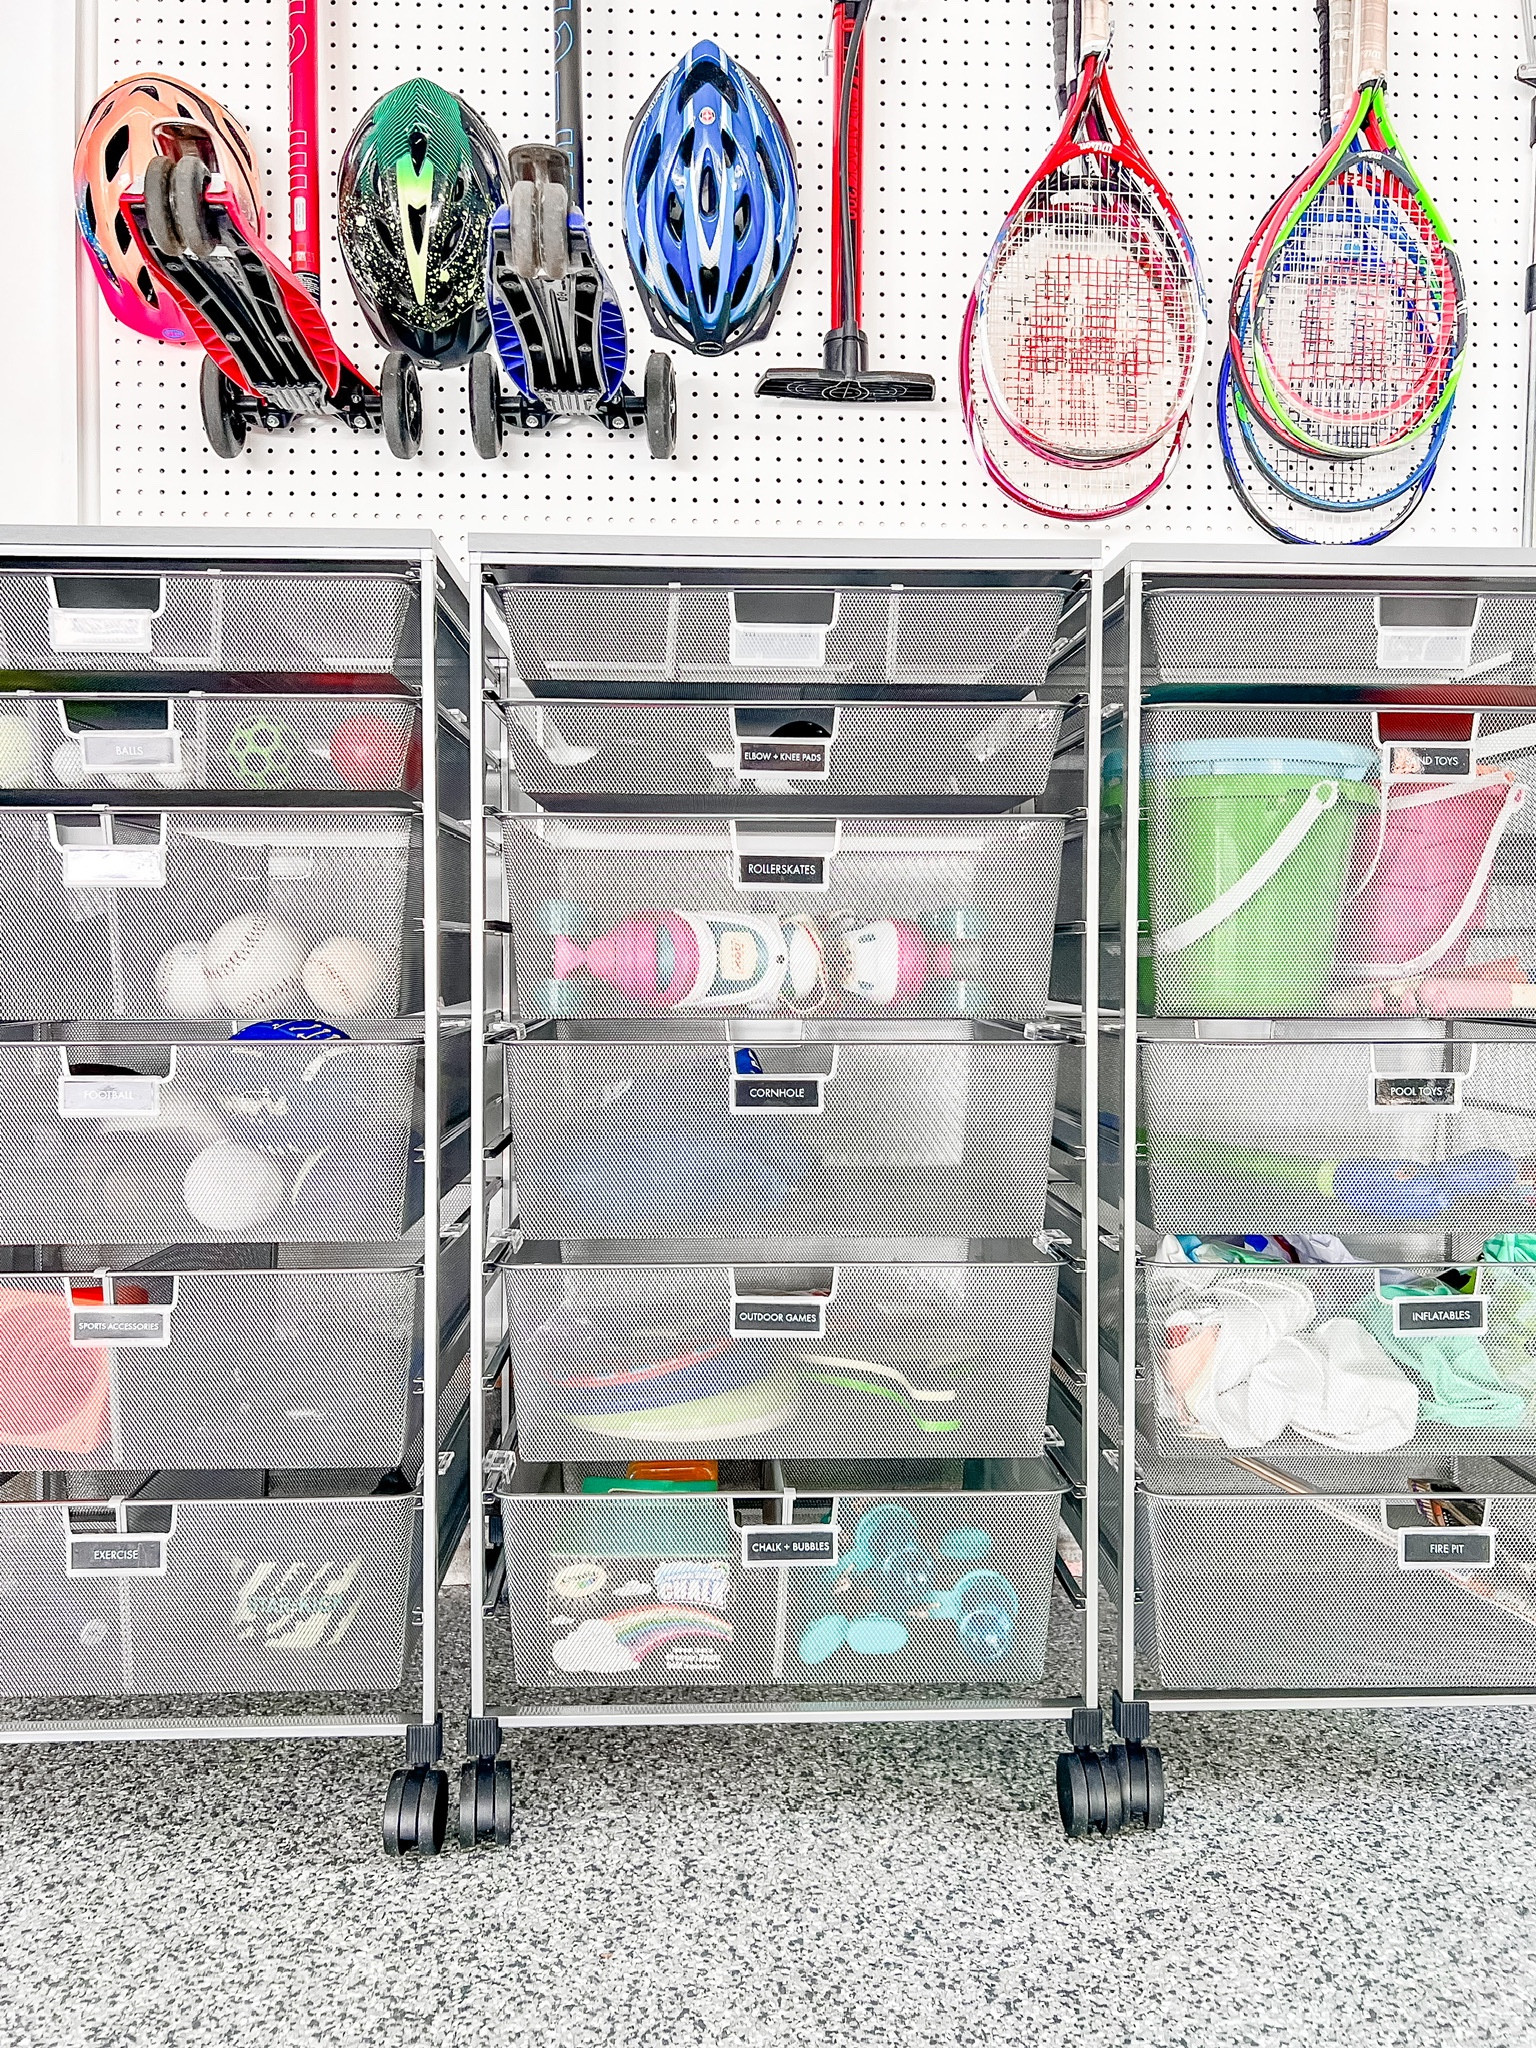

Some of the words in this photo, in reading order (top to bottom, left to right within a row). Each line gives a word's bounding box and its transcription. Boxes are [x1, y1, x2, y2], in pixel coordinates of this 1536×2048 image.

[115, 745, 144, 756] BALLS
[744, 751, 772, 761] ELBOW
[780, 752, 801, 762] KNEE
[802, 753, 822, 763] PADS
[1405, 756, 1433, 767] SAND
[1434, 756, 1459, 767] TOYS
[748, 863, 816, 875] ROLLERSKATES
[83, 1090, 134, 1101] FOOTBALL
[749, 1087, 805, 1098] CORNHOLE
[1390, 1086, 1417, 1097] POOL
[1418, 1086, 1443, 1097] TOYS
[739, 1312, 784, 1322] OUTDOOR
[785, 1313, 817, 1323] GAMES
[1412, 1310, 1471, 1322] INFLATABLES
[78, 1322, 107, 1331] SPORTS
[107, 1322, 159, 1332] ACCESSORIES
[751, 1543, 782, 1553] CHALK
[783, 1543, 791, 1551] +
[792, 1541, 830, 1552] BUBBLES
[1430, 1544, 1449, 1554] FIRE
[1451, 1544, 1465, 1554] PIT
[93, 1549, 139, 1560] EXERCISE
